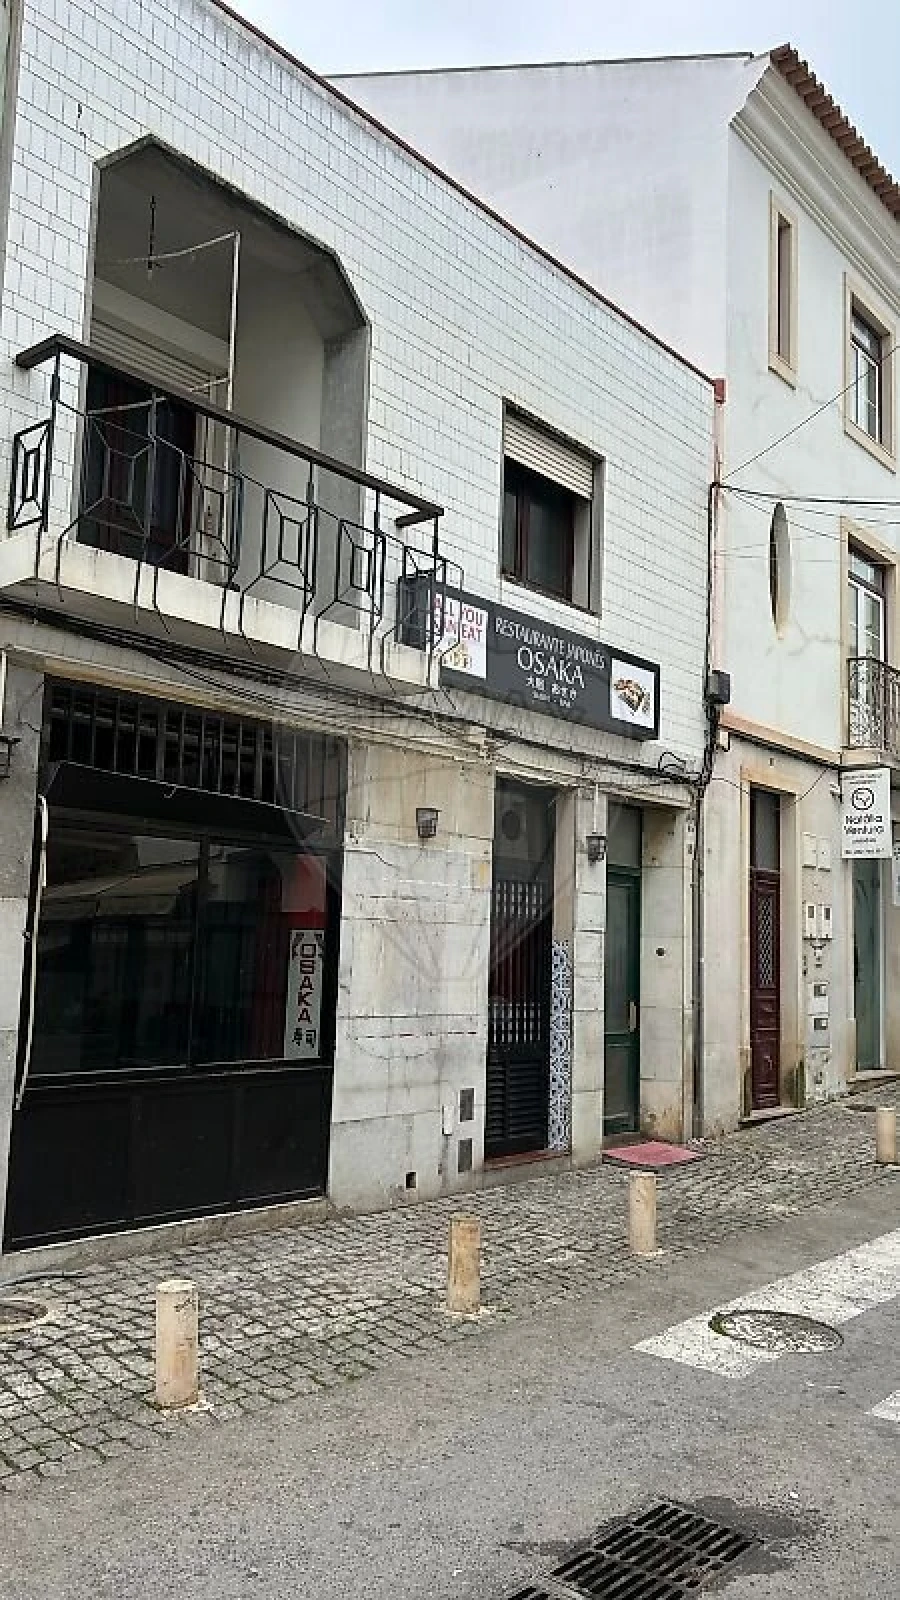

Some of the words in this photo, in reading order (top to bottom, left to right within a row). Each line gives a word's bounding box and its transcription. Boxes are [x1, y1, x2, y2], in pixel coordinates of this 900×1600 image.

[461, 623, 482, 643] EAT
[493, 616, 565, 656] RESTAURANTE
[517, 645, 586, 689] OSAKA
[297, 943, 317, 1025] OSAKA
